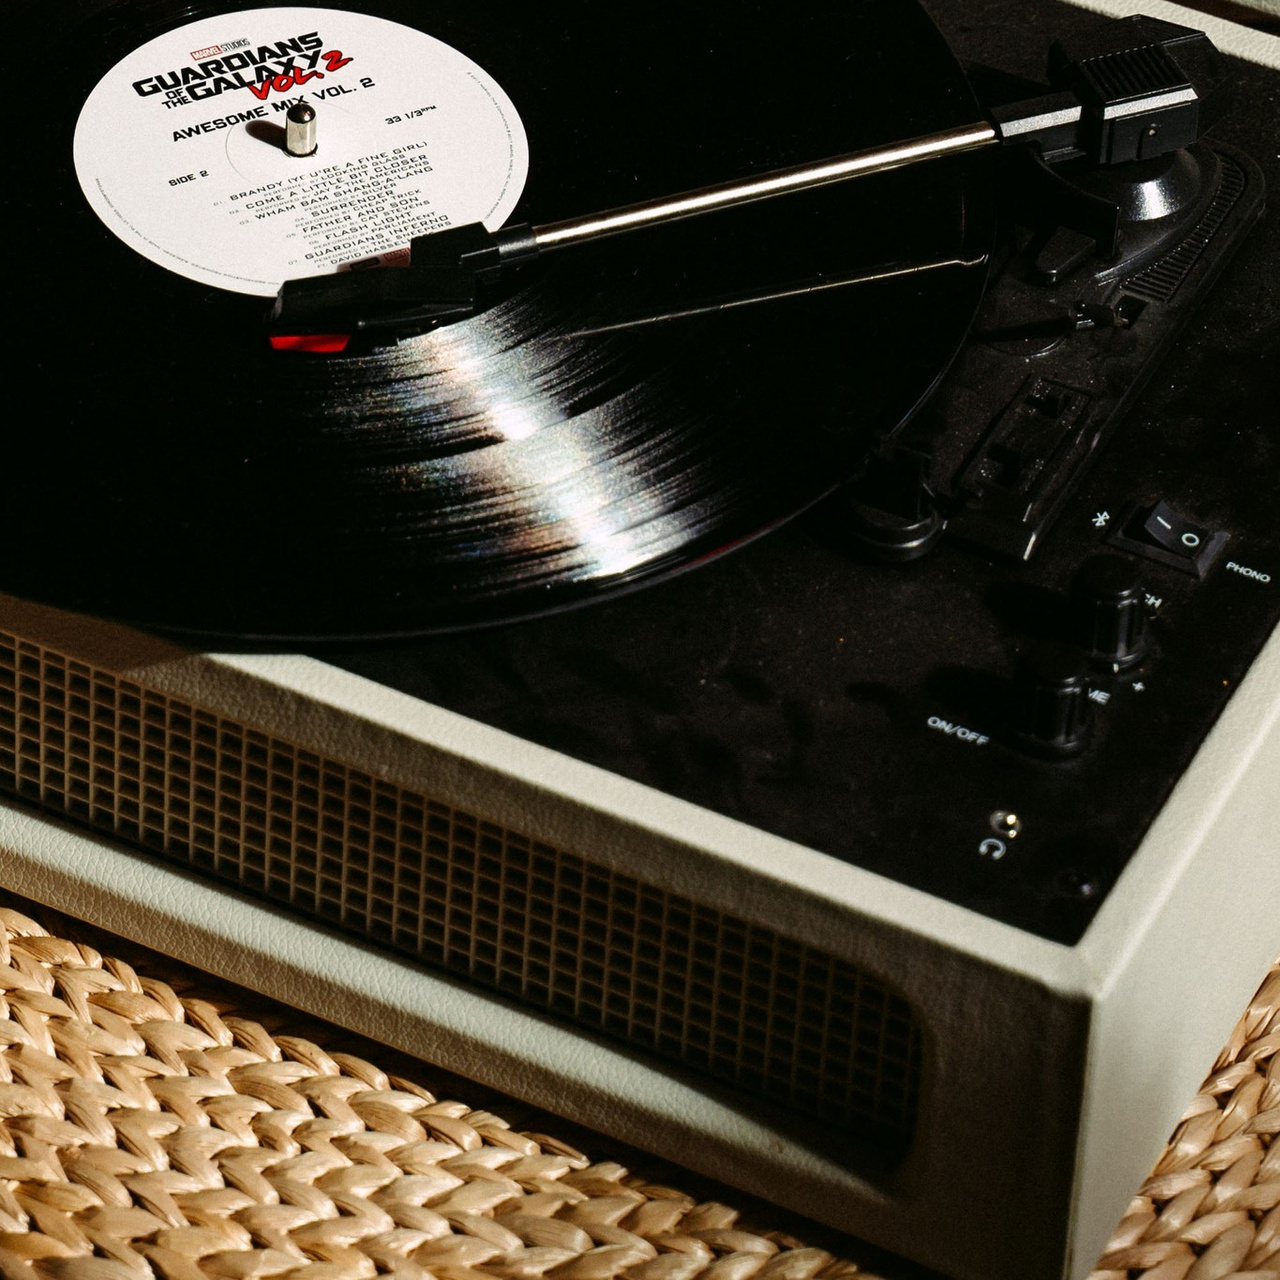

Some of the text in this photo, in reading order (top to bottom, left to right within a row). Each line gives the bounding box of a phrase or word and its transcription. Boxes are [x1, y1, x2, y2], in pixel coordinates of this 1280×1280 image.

[190, 38, 250, 61] MARVEL STUDIOS
[322, 50, 354, 72] 2
[132, 32, 323, 97] GUARDIANS
[186, 51, 324, 100] GALAXY
[162, 96, 192, 109] THE
[166, 88, 184, 98] OF
[172, 78, 376, 142] AWESOME MIX VOL. 2
[385, 116, 401, 124] 33
[230, 181, 282, 201] BRANDY
[358, 152, 388, 163] FINE
[393, 141, 428, 155] GIRL)
[314, 188, 330, 196] JAY
[346, 179, 365, 187] THE
[370, 160, 430, 180] AMERICANS
[321, 164, 368, 180] LOOKING
[372, 154, 405, 167] GLASS
[169, 174, 196, 187] SIDE
[246, 195, 284, 209] COME
[302, 177, 345, 193] LITTLE
[349, 170, 369, 180] BIT
[374, 155, 428, 173] CLOSER
[255, 205, 296, 219] WHAM
[300, 195, 329, 207] BAM
[334, 166, 433, 197] SHANG-A-LANG
[362, 183, 397, 195] SILVER
[311, 189, 394, 217] SURRENDER
[353, 199, 388, 211] CHEAP
[392, 189, 422, 199] TRICK
[361, 214, 379, 222] CAT
[383, 200, 430, 216] STEVENS
[303, 215, 351, 233] FATHER
[358, 206, 385, 217] AND
[390, 197, 419, 208] SON
[325, 224, 368, 240] FLASH
[373, 211, 411, 226] LIGHT
[371, 211, 436, 233] PARLIAMENT
[305, 233, 384, 260] GUARDIANS
[389, 215, 448, 235] INFERNO
[372, 238, 392, 246] THE
[396, 221, 452, 240] SNEEPERS
[330, 252, 361, 265] DAVID
[1226, 561, 1271, 583] PHONO
[927, 716, 990, 746] ON/OFF
